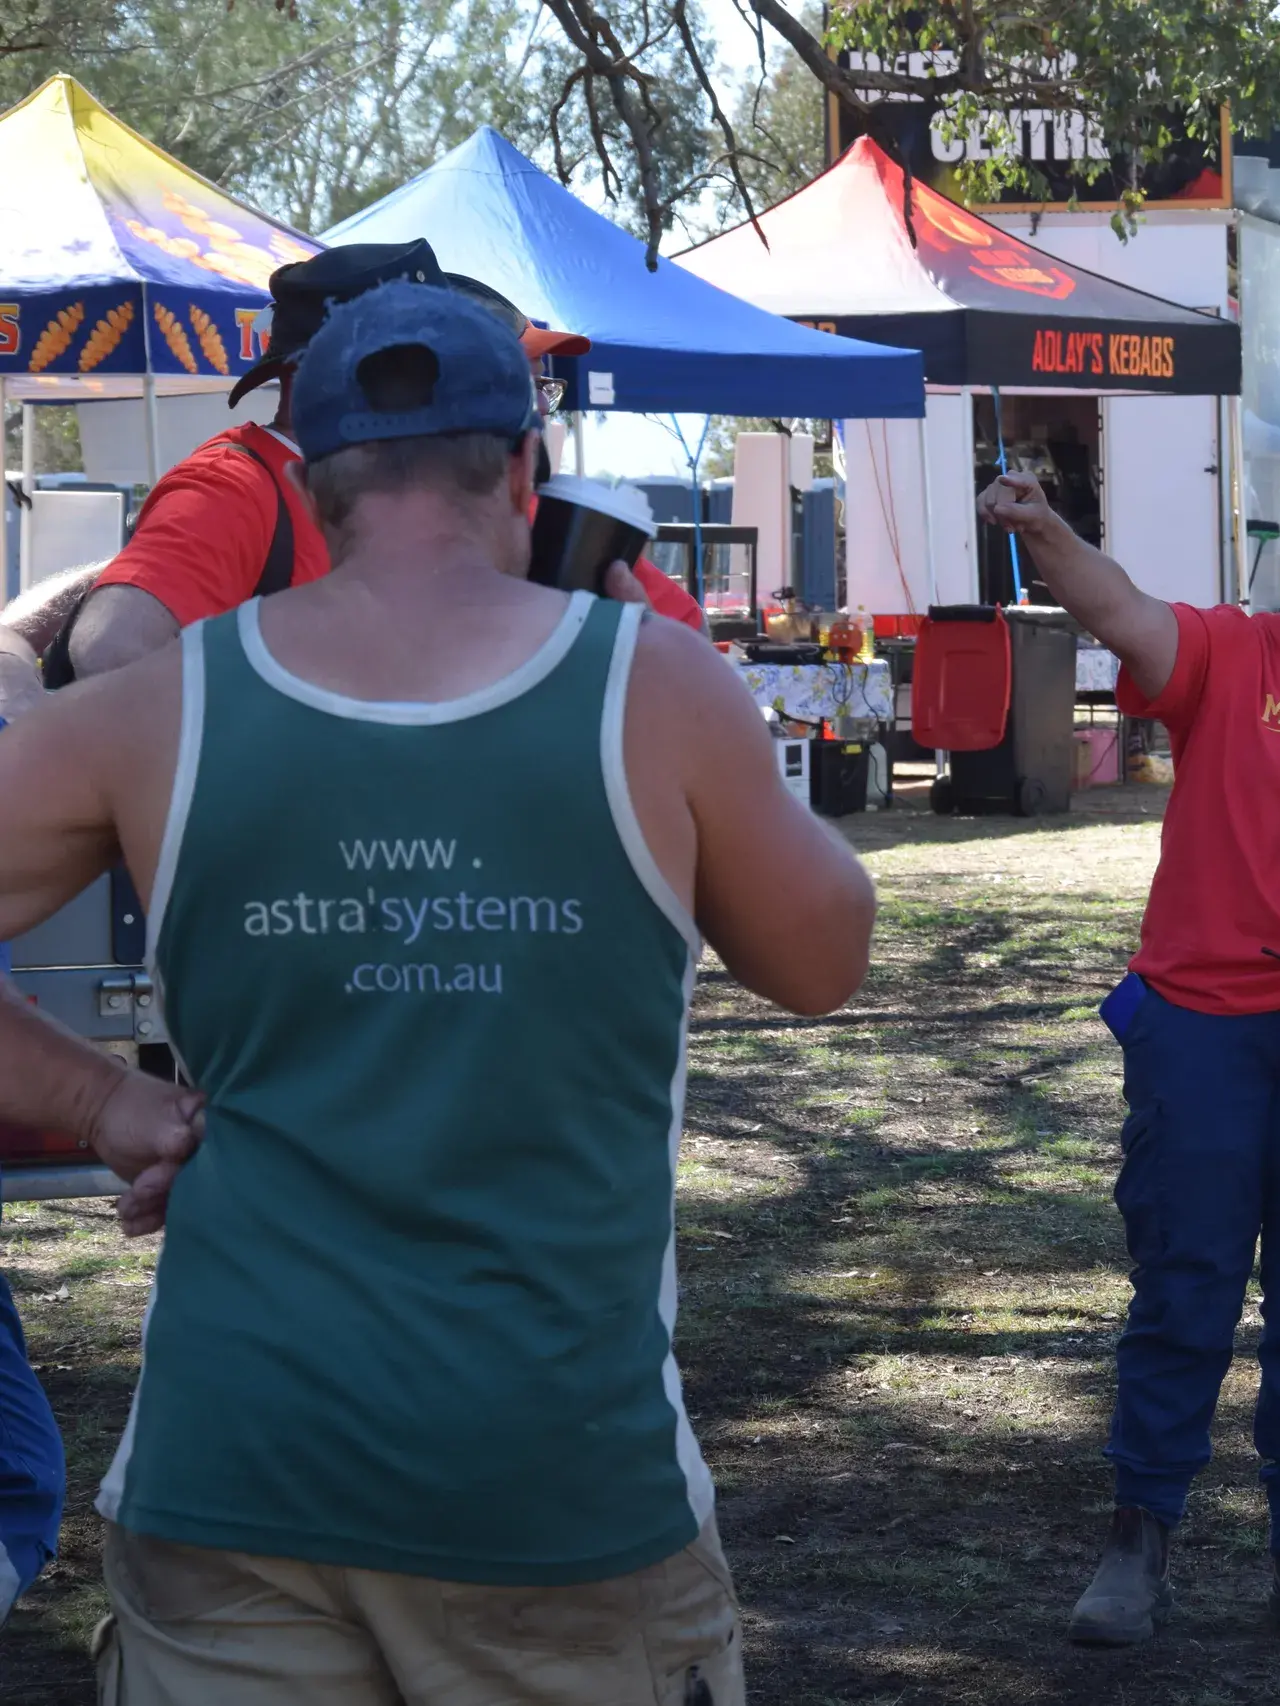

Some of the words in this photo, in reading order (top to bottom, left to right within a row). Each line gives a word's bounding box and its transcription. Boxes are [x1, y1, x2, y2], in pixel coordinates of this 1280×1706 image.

[929, 108, 1112, 163] CENTRE
[1031, 329, 1104, 374] ADLAY'S
[1108, 333, 1175, 379] KEBABS
[343, 962, 503, 994] .com.au
